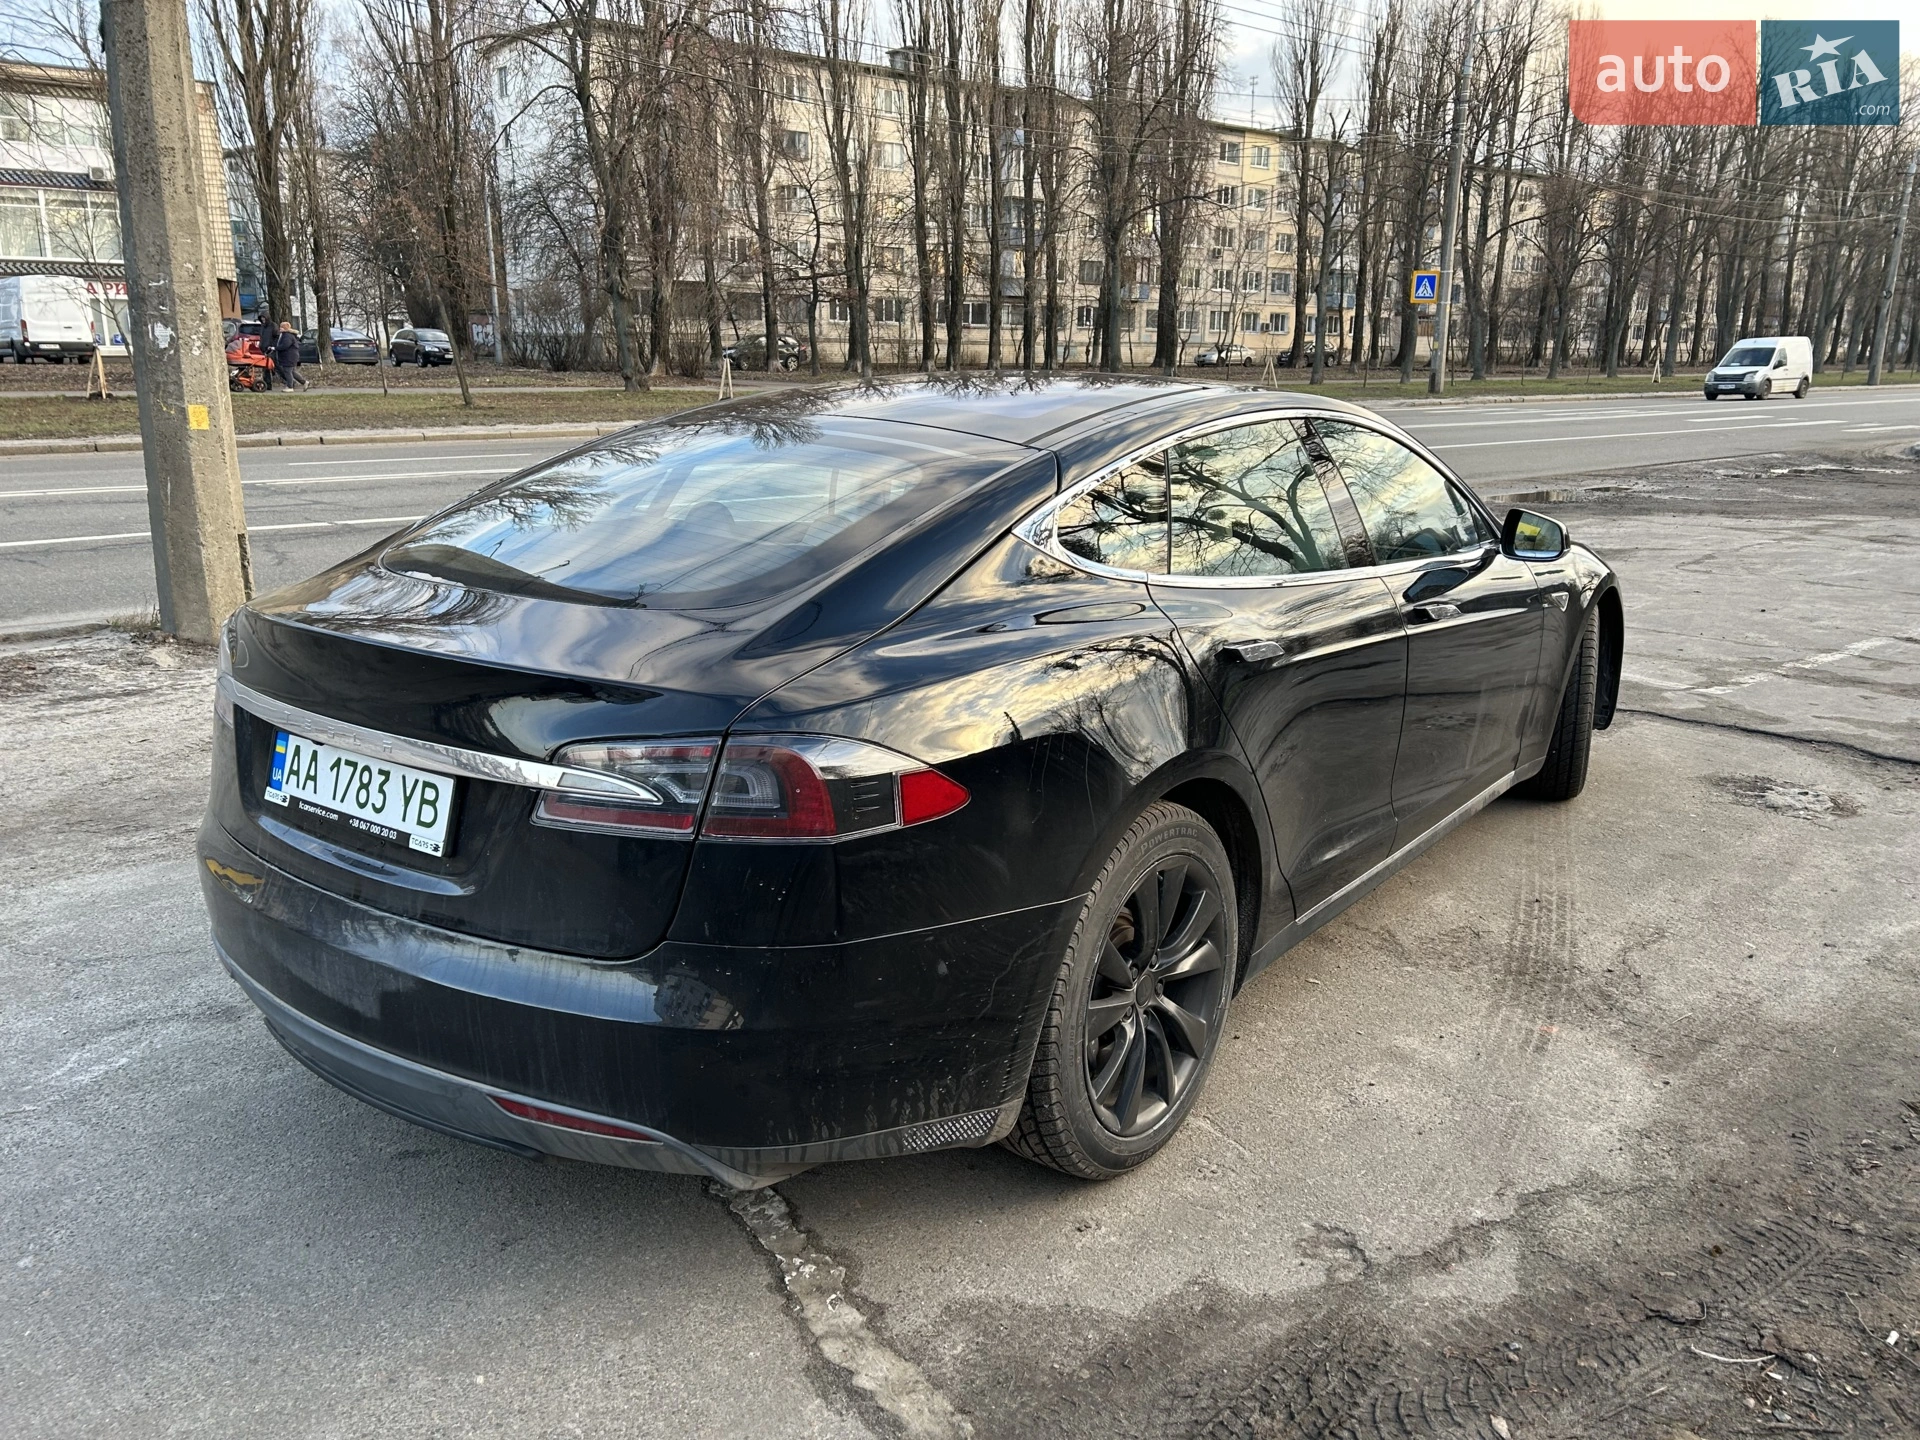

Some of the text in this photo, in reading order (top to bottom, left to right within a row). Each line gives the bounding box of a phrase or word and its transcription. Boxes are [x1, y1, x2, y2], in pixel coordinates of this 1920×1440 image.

[284, 710, 393, 754] TESLA
[272, 767, 282, 782] UA
[285, 744, 439, 829] AA 1783 YB
[1140, 826, 1198, 855] POWERTRAC
